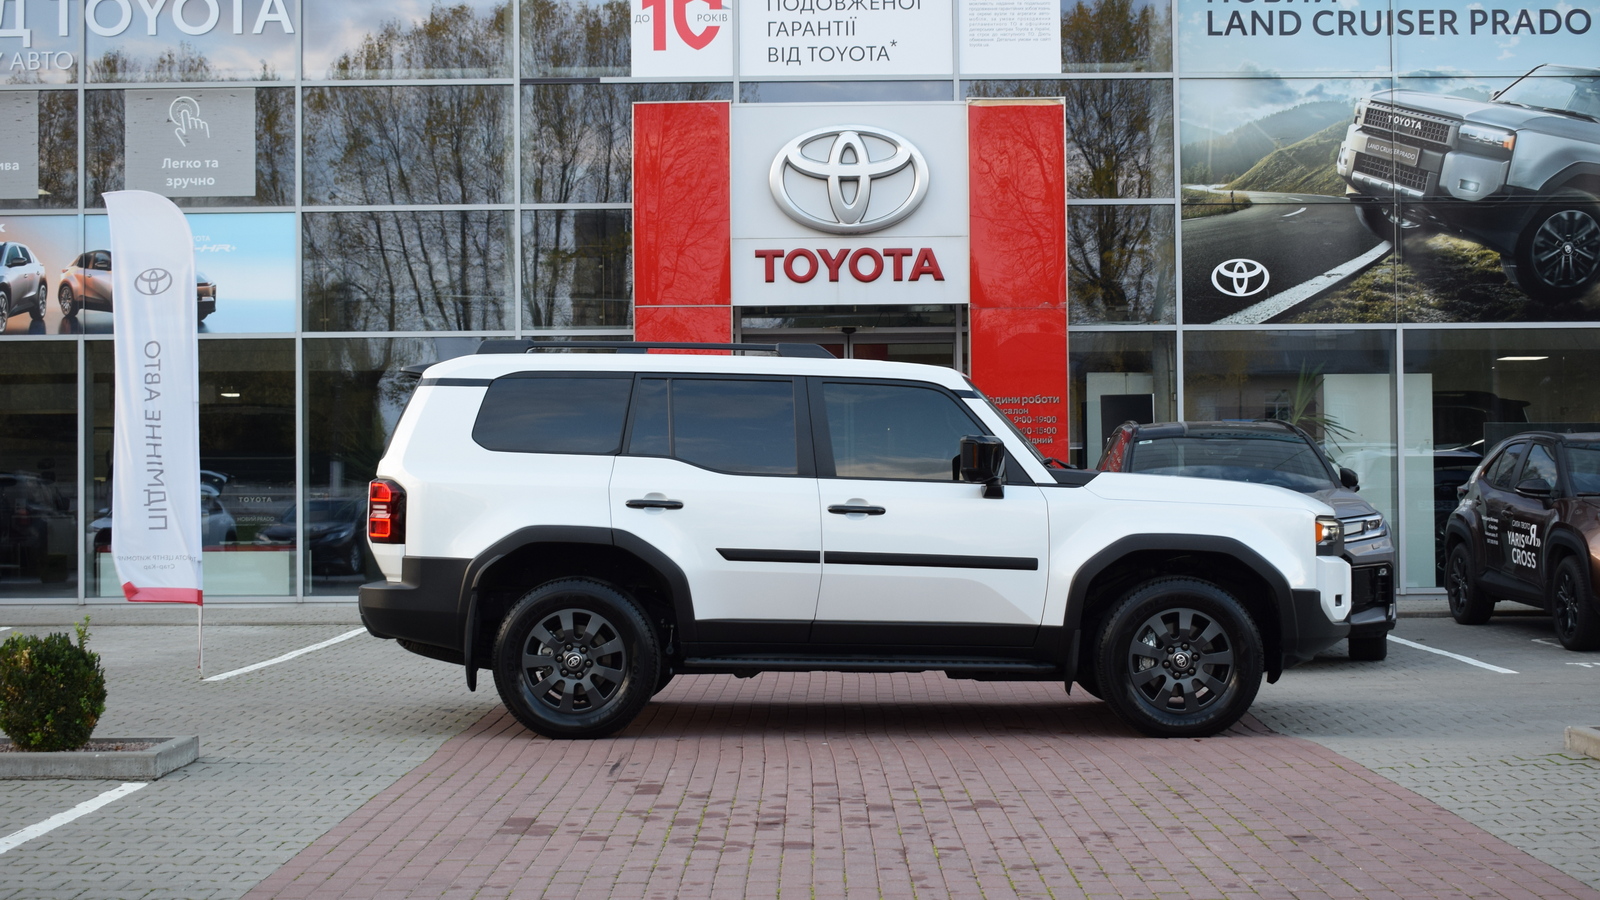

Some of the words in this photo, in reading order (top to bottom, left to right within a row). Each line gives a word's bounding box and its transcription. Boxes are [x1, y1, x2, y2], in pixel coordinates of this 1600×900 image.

[50, 0, 296, 37] TOYOTA
[634, 14, 650, 23] ДО
[696, 14, 728, 22] РОКІВ
[767, 17, 857, 37] ГАРАНТІЇ
[1207, 10, 1302, 36] LAND
[1312, 9, 1459, 36] CRUISER
[1470, 9, 1592, 35] PRADO
[10, 51, 74, 70] АВТО
[767, 46, 801, 65] ВІД
[1388, 116, 1422, 130] TOYOTA
[162, 158, 201, 171] Легко
[205, 160, 219, 169] та
[166, 176, 215, 188] зручно
[755, 248, 944, 283] TOYOTA
[987, 396, 1020, 404] одини
[1022, 395, 1059, 406] роботи
[1507, 530, 1525, 548] YARIS
[1512, 548, 1536, 568] CROSS
